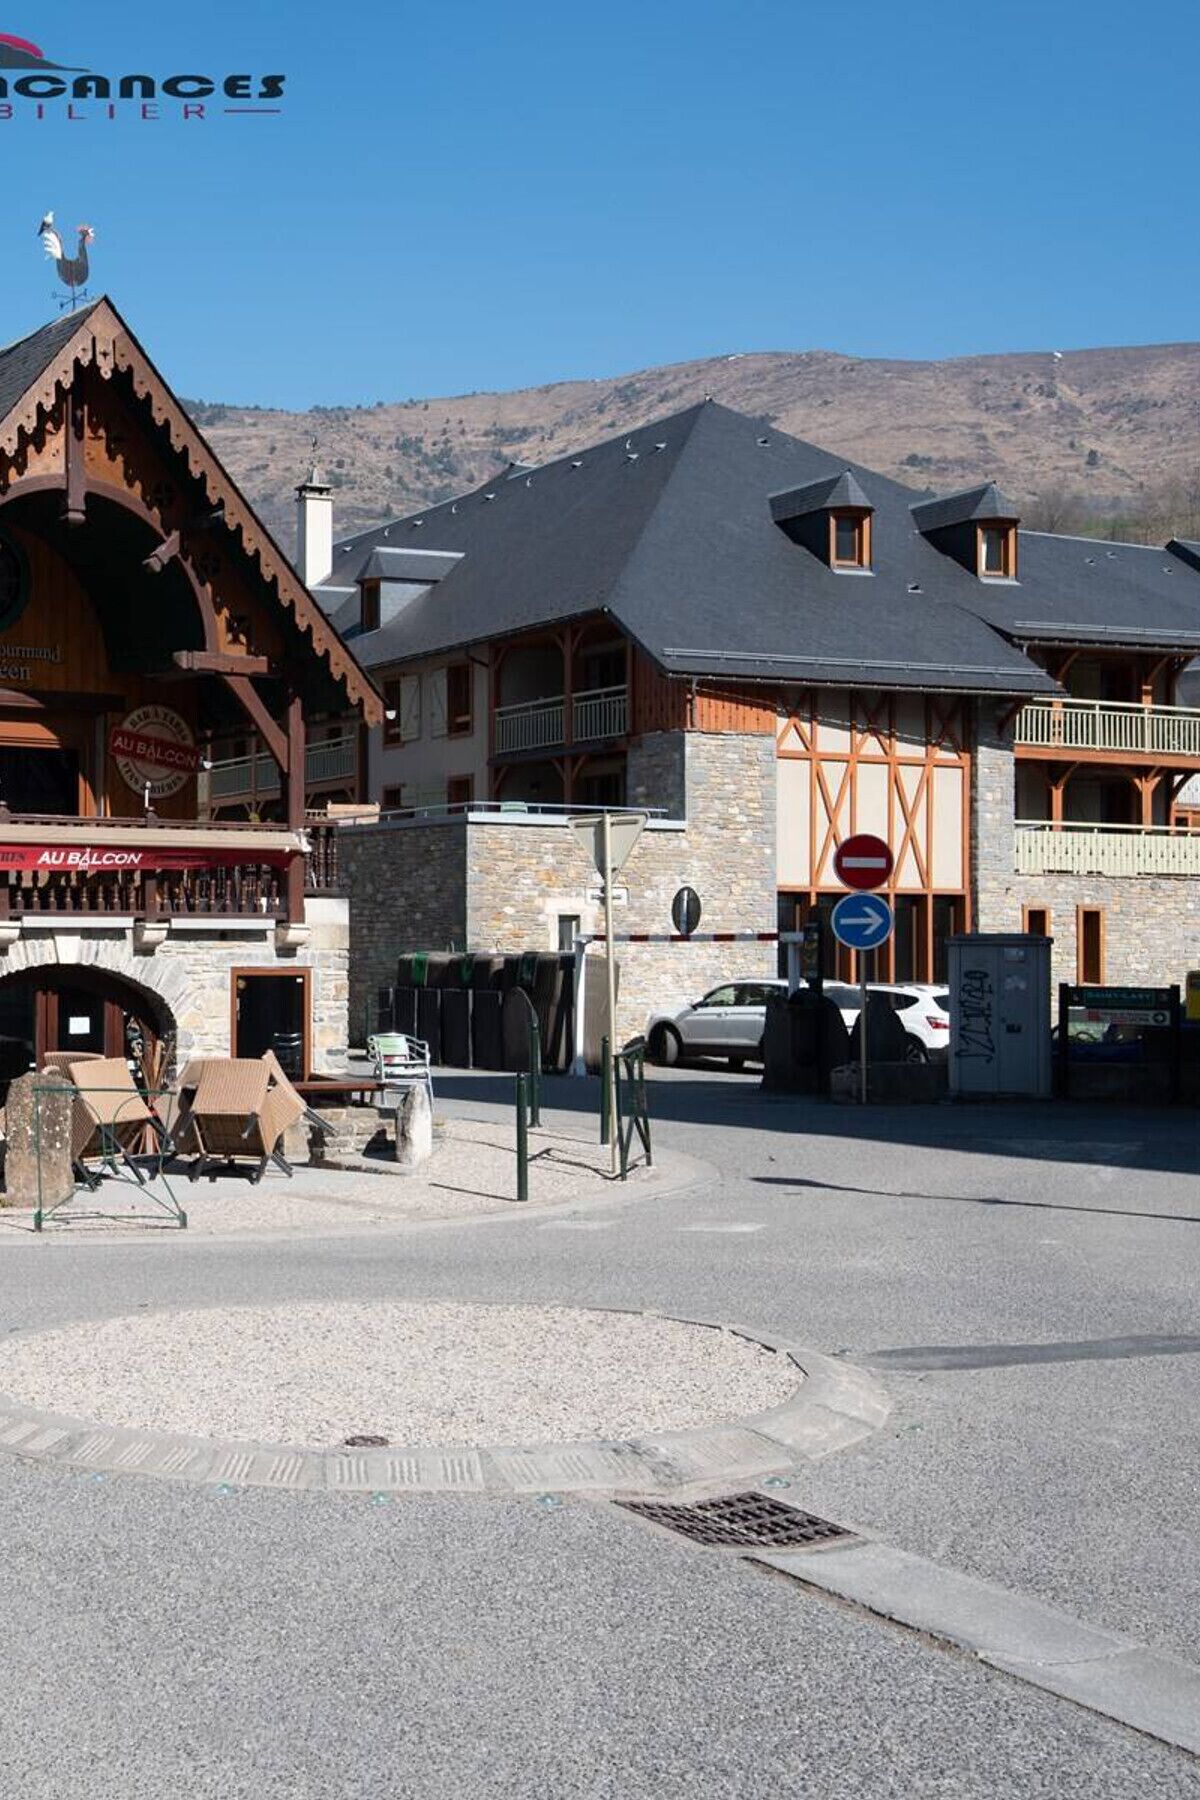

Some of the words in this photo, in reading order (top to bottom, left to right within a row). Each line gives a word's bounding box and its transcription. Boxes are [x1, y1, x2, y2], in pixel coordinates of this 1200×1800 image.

[113, 736, 134, 751] AU
[136, 741, 197, 769] BALCON
[37, 851, 65, 865] AU
[66, 850, 143, 867] BALCON
